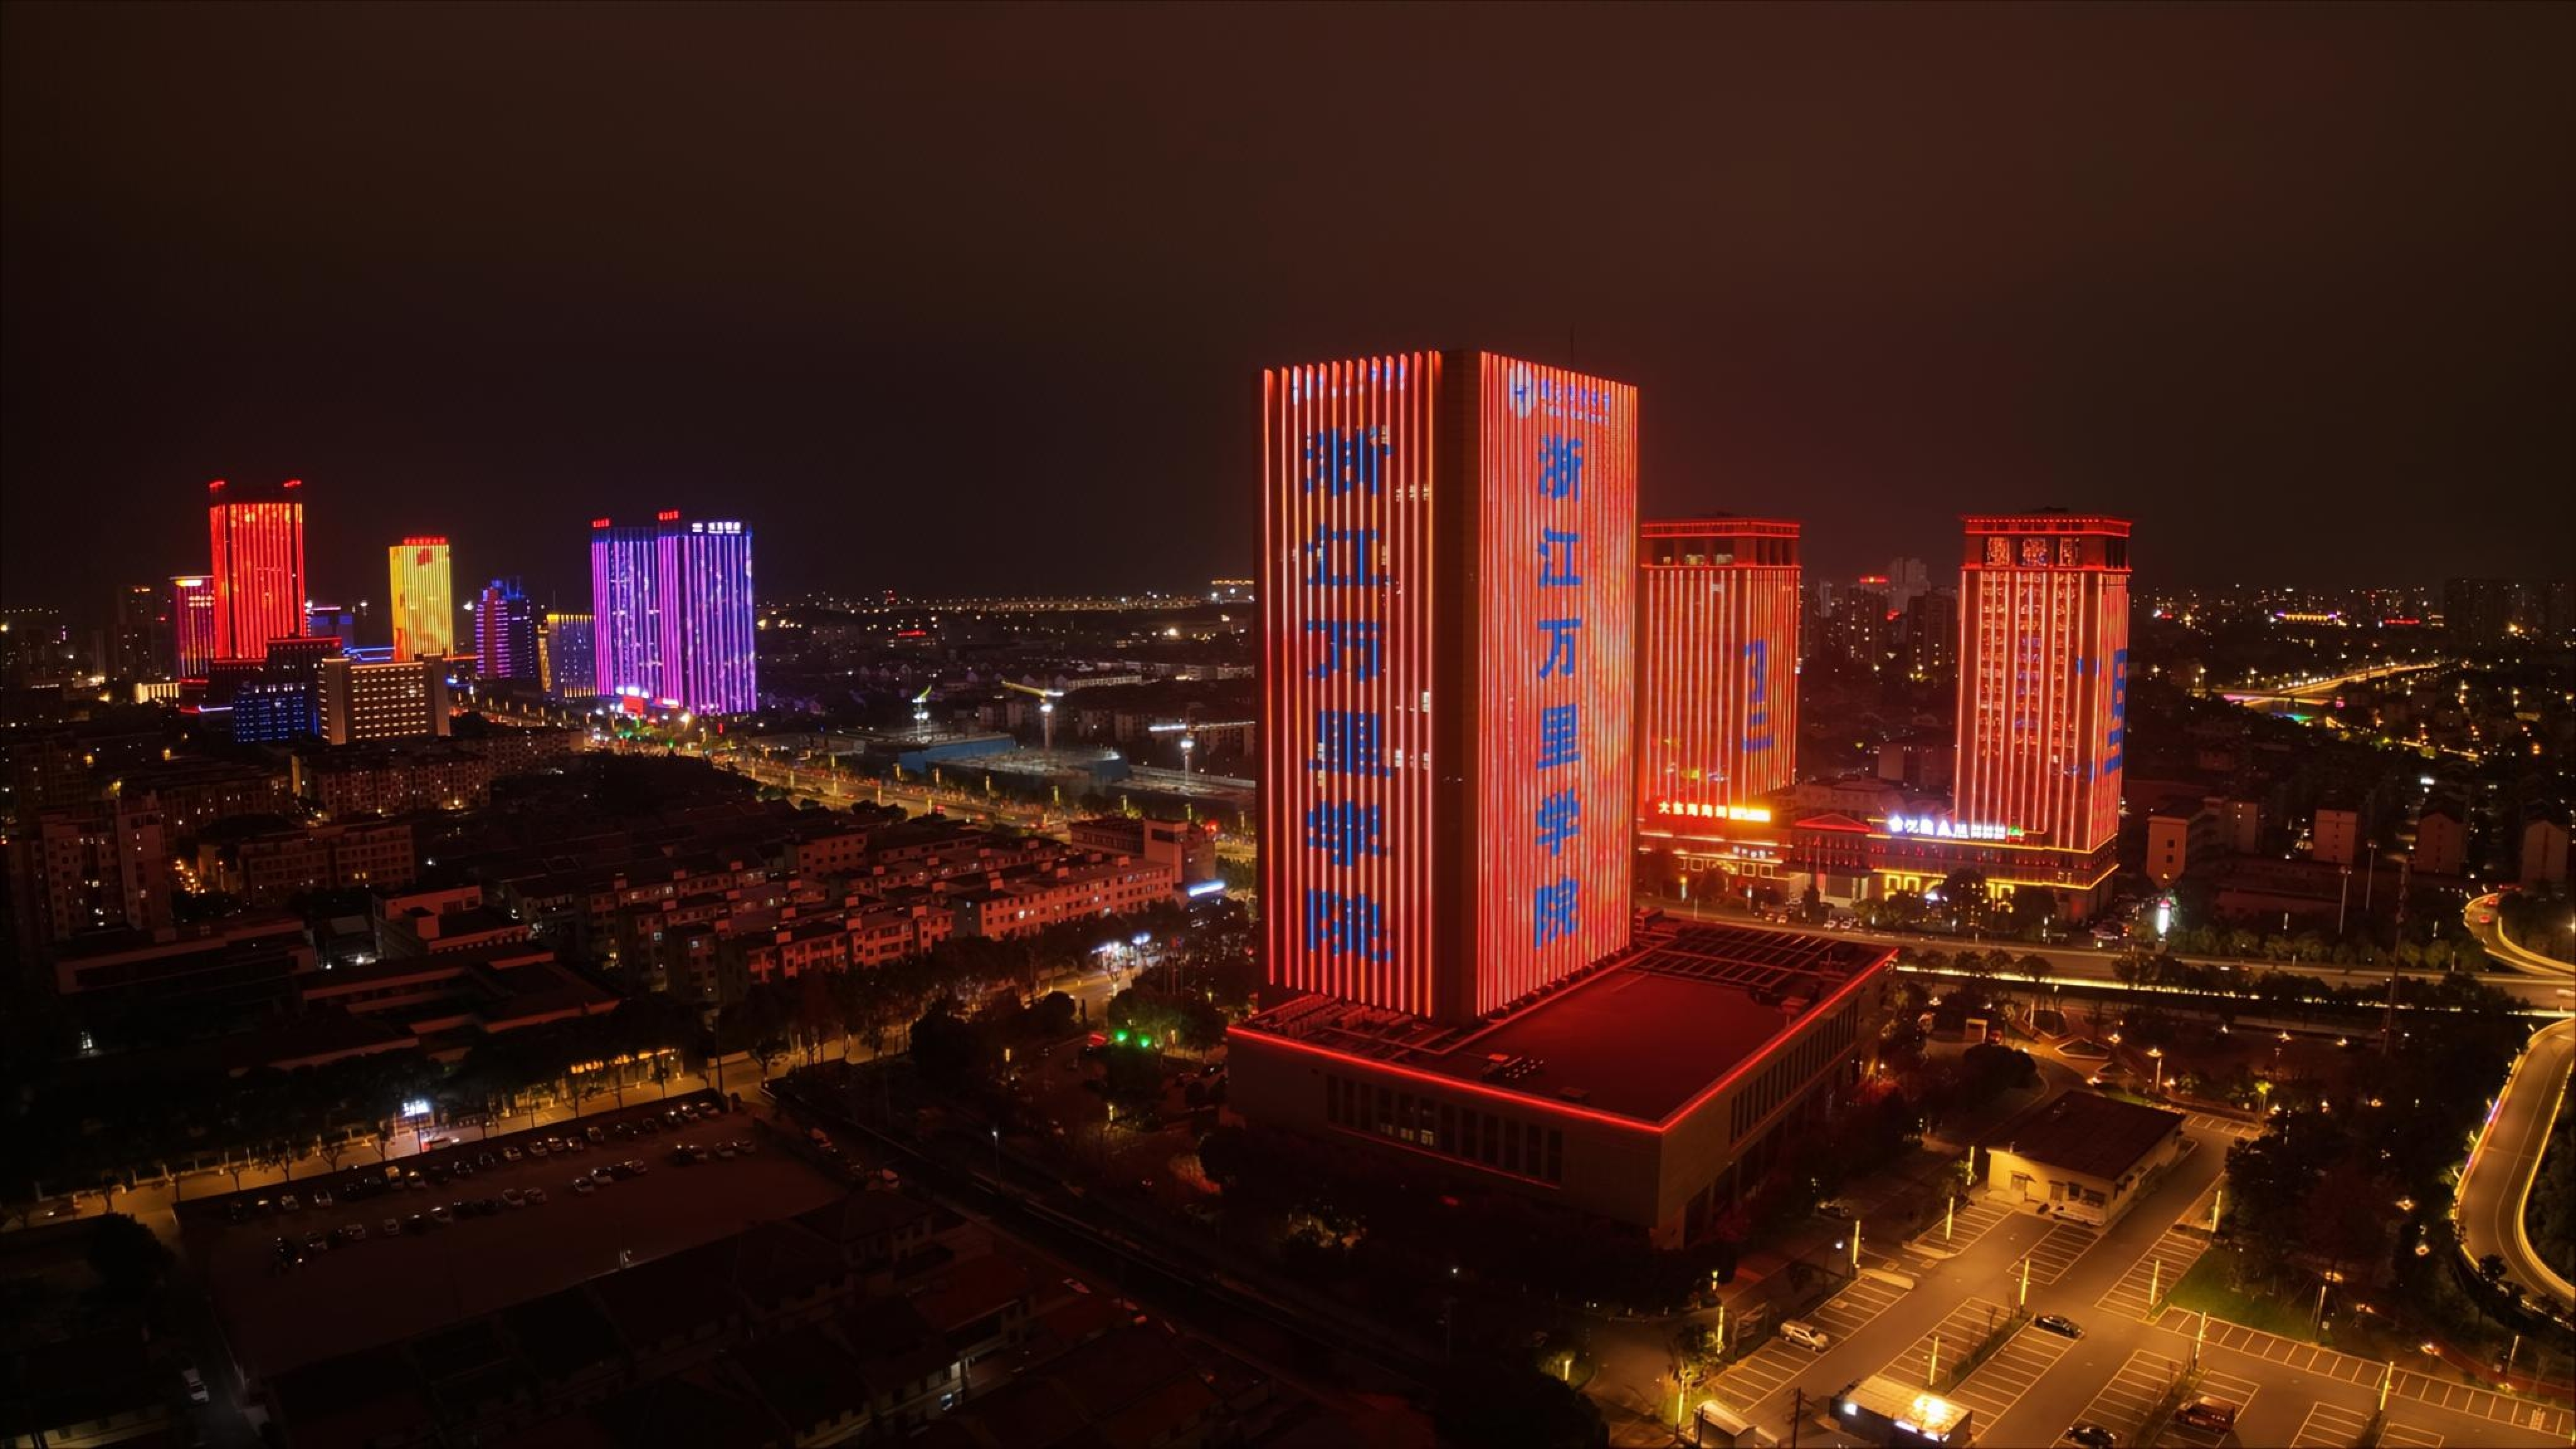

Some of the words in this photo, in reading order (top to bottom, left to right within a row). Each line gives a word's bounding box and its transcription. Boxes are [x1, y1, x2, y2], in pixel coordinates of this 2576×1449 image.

[1535, 434, 1584, 950] 浙江万里学院
